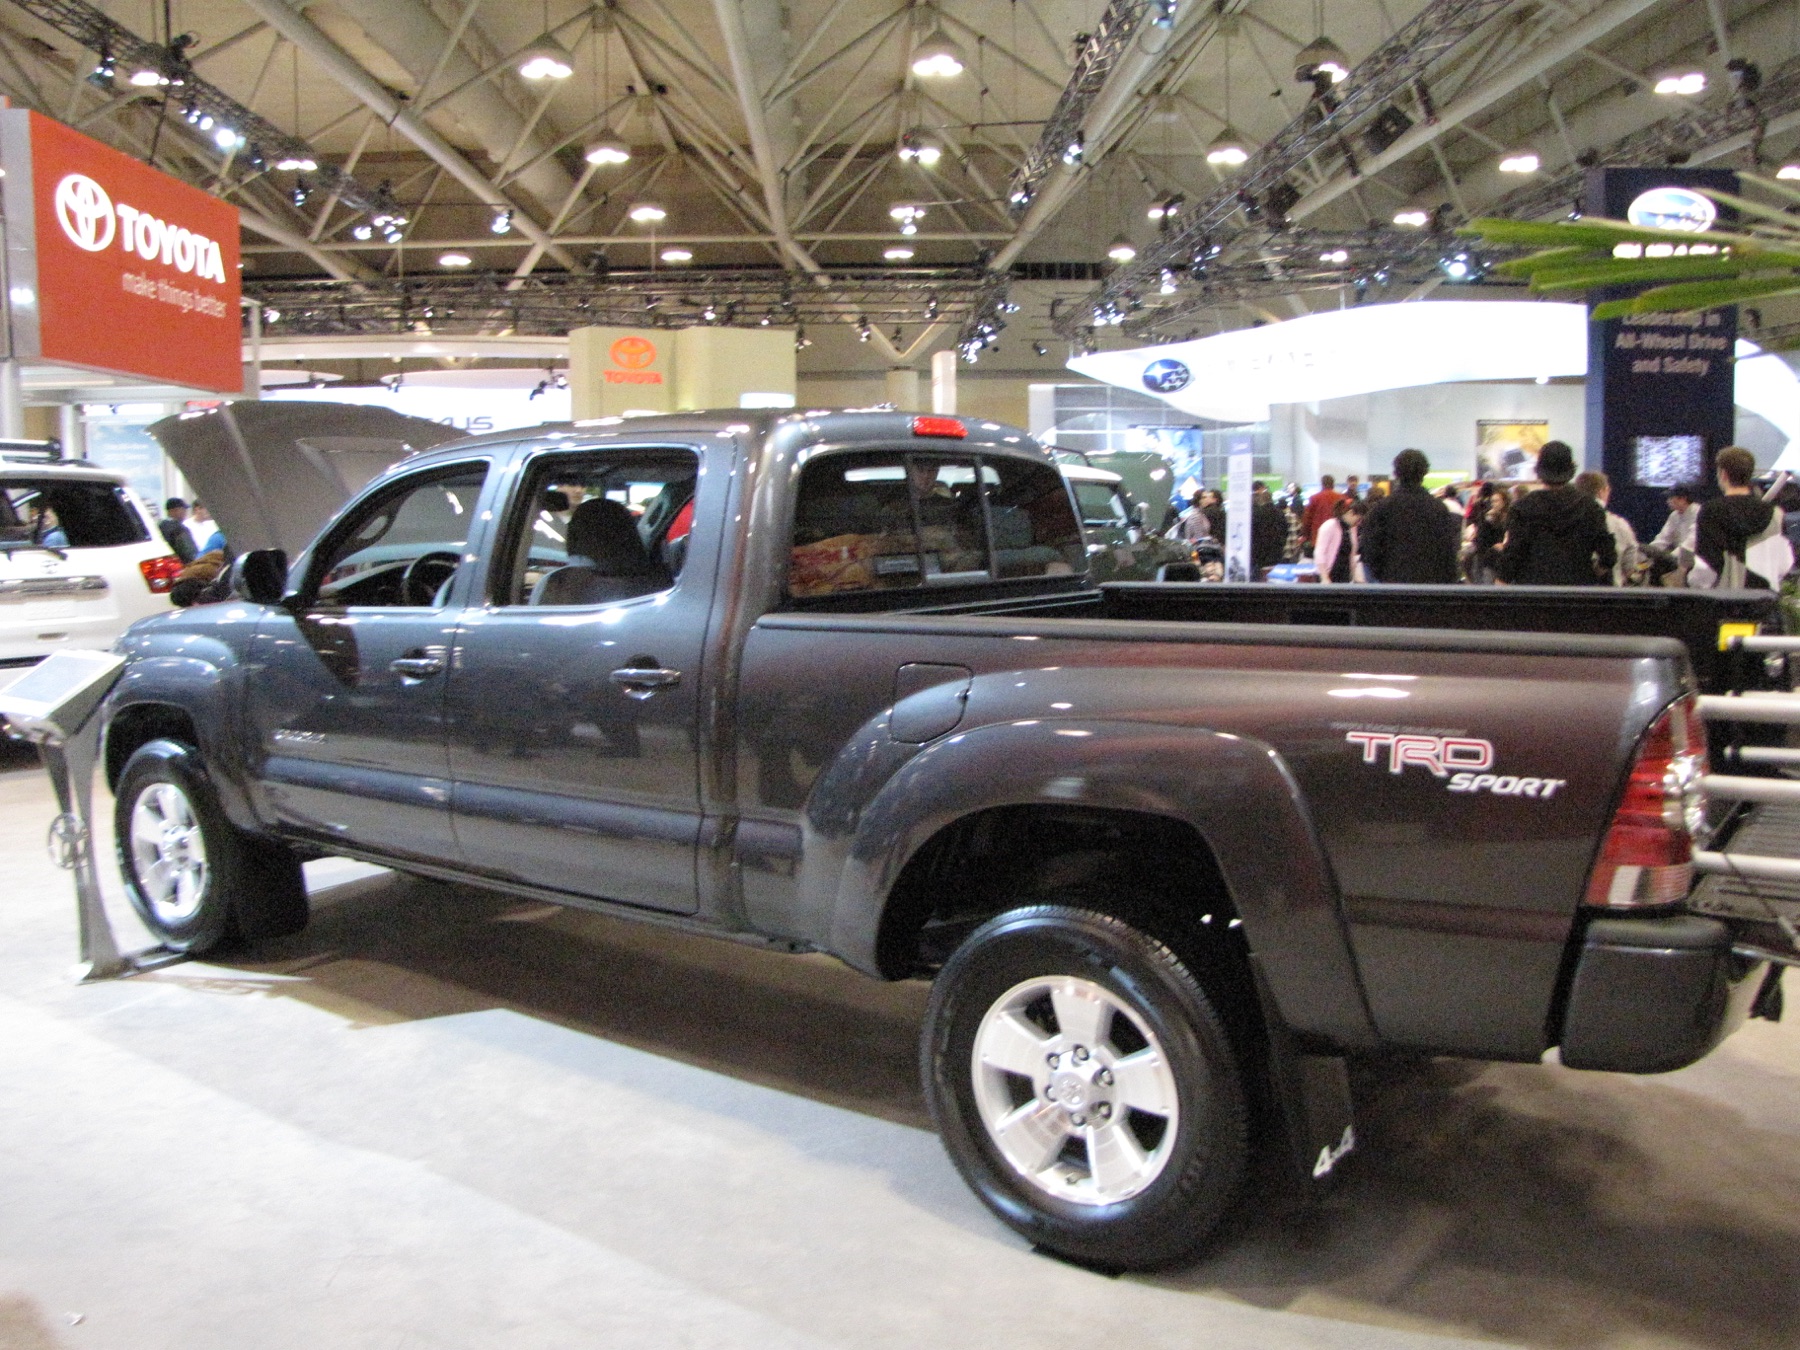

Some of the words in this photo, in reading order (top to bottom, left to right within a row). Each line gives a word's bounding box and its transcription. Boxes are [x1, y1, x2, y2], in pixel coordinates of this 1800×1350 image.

[116, 203, 226, 284] TOYOTA
[122, 271, 157, 299] make
[157, 279, 194, 314] things
[193, 289, 227, 319] better
[1615, 332, 1685, 350] All-Wheel
[1688, 333, 1728, 350] Drive
[603, 370, 664, 385] TOYOTA
[1631, 357, 1661, 374] and
[1663, 356, 1710, 377] Safety
[1346, 731, 1494, 777] TRD
[1447, 773, 1566, 797] SPORT
